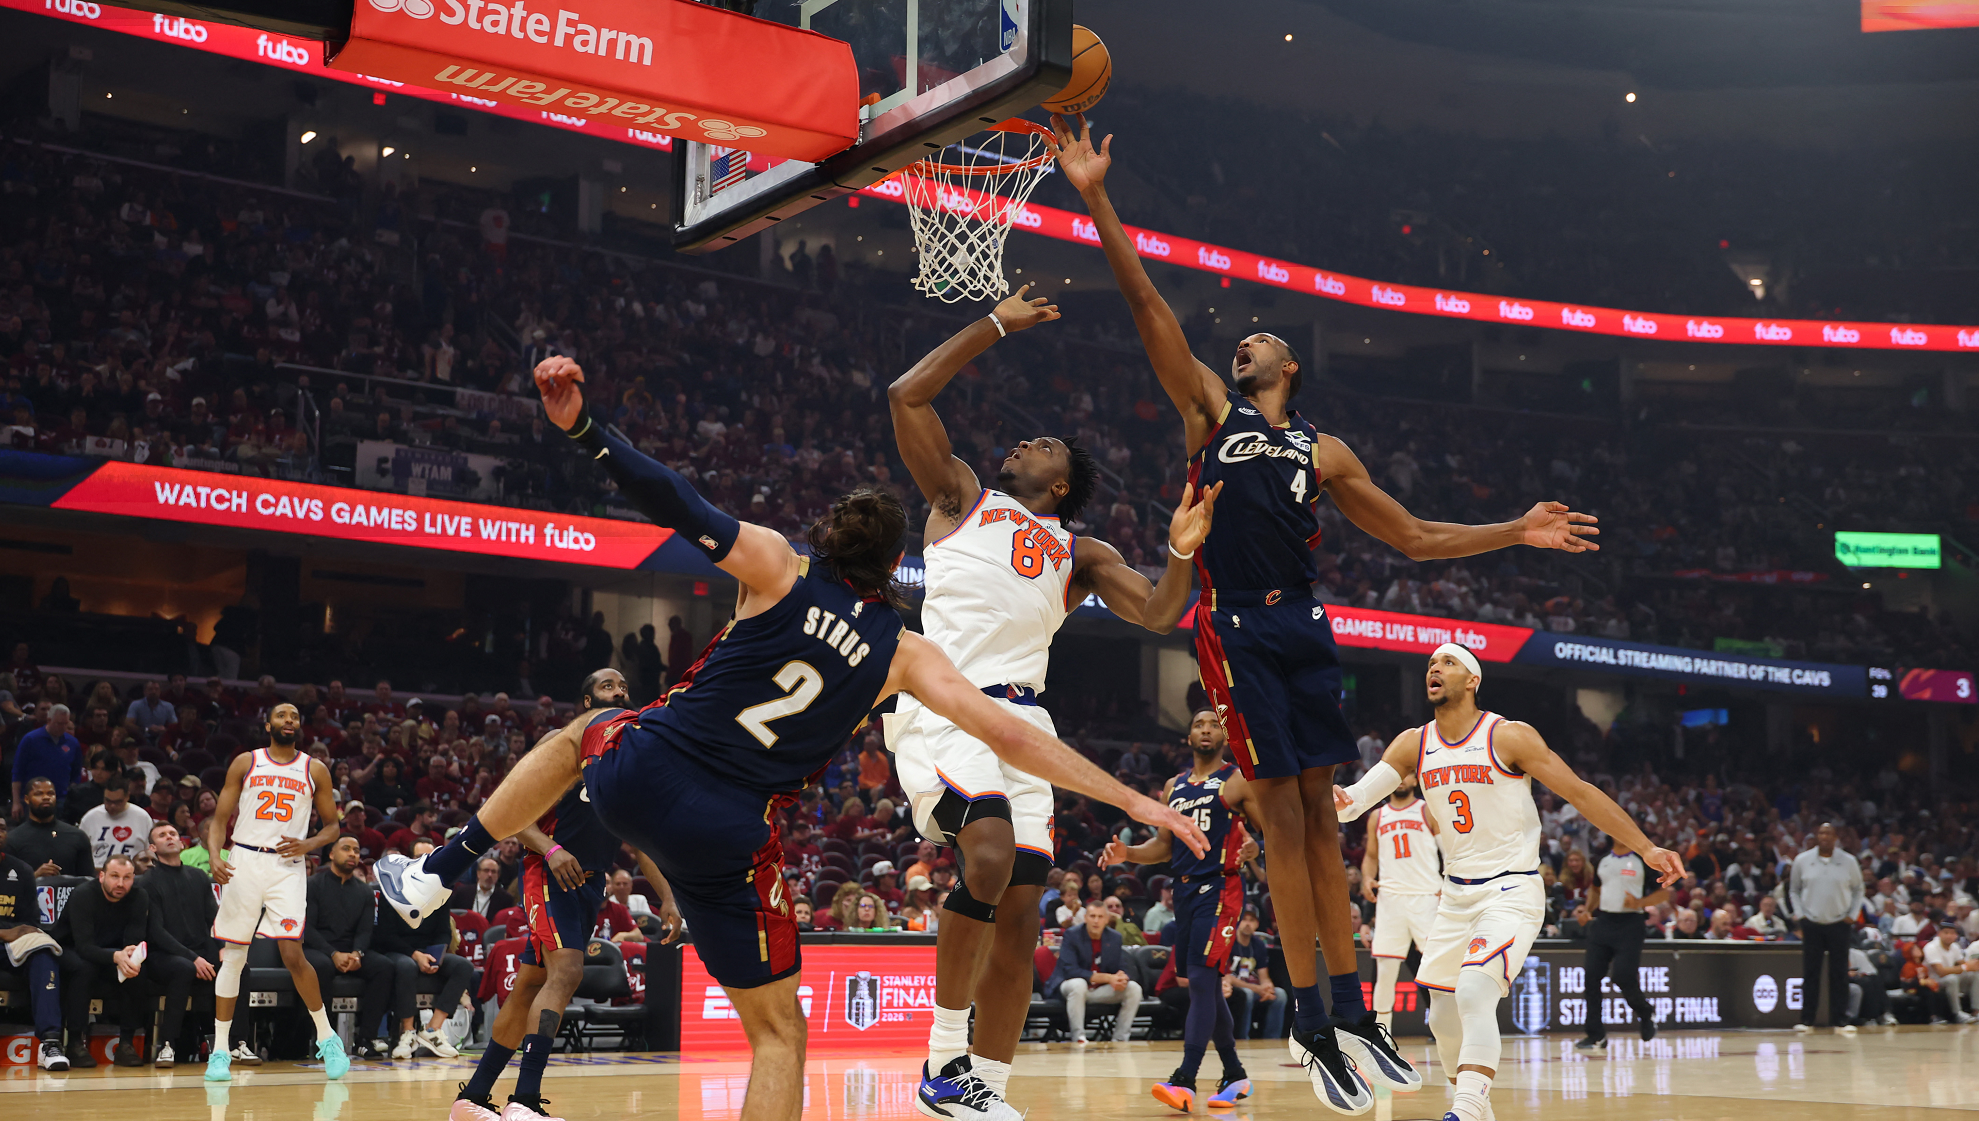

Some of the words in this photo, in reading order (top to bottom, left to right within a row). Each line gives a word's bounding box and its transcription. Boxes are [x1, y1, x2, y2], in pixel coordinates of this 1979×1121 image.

[153, 13, 208, 43] fubo
[257, 34, 309, 65] fubo
[1136, 232, 1170, 257] fubo
[1198, 246, 1231, 270] fubo
[1257, 260, 1289, 283] fubo
[1314, 273, 1346, 296] fubo
[1371, 285, 1406, 306] fubo
[1434, 293, 1470, 313] fubo
[1499, 300, 1534, 321] fubo
[1561, 307, 1596, 328] fubo
[1623, 314, 1657, 335] fubo
[1686, 319, 1724, 339] fubo
[1754, 322, 1792, 341] fubo
[1822, 325, 1860, 344] fubo
[1890, 327, 1928, 346] fubo
[1218, 431, 1309, 465] CLEVELAND
[411, 462, 453, 481] WTAM
[1290, 468, 1308, 504] 4
[154, 481, 248, 513] WATCH
[256, 493, 324, 521] CAVS
[330, 502, 417, 531] GAMES
[424, 512, 473, 537] LIVE
[478, 519, 535, 545] WITH
[544, 523, 596, 551] fubo
[978, 508, 1029, 528] NEW
[1023, 518, 1071, 572] YORK
[1913, 546, 1937, 556] Bank
[1011, 529, 1044, 580] 8
[803, 606, 871, 668] STRUS
[1332, 617, 1383, 639] GAMES
[1385, 625, 1414, 642] LIVE
[1417, 628, 1450, 646] WITH
[1453, 628, 1487, 650] fubo
[1554, 641, 1617, 665] OFFICIAL
[1617, 648, 1693, 673] STREAMING
[1693, 657, 1748, 680] PARTNER
[1748, 664, 1766, 681] OF
[1766, 666, 1792, 684] THE
[1791, 668, 1832, 687] CAVS
[1956, 677, 1971, 699] 3
[734, 659, 824, 748] 2
[249, 774, 277, 789] NEW
[277, 775, 307, 797] YORK
[1422, 765, 1452, 791] NEW
[1451, 764, 1495, 785] YORK
[255, 790, 296, 823] 25
[1448, 789, 1475, 835] 3
[1191, 808, 1211, 832] 45
[1379, 820, 1397, 836] NEW
[1399, 819, 1424, 832] YORK
[97, 826, 111, 842] I
[1392, 832, 1412, 860] 11
[882, 975, 926, 986] STANLEY
[882, 1013, 904, 1022] 2026
[1675, 997, 1722, 1023] FINAL
[6, 1037, 32, 1064] G
